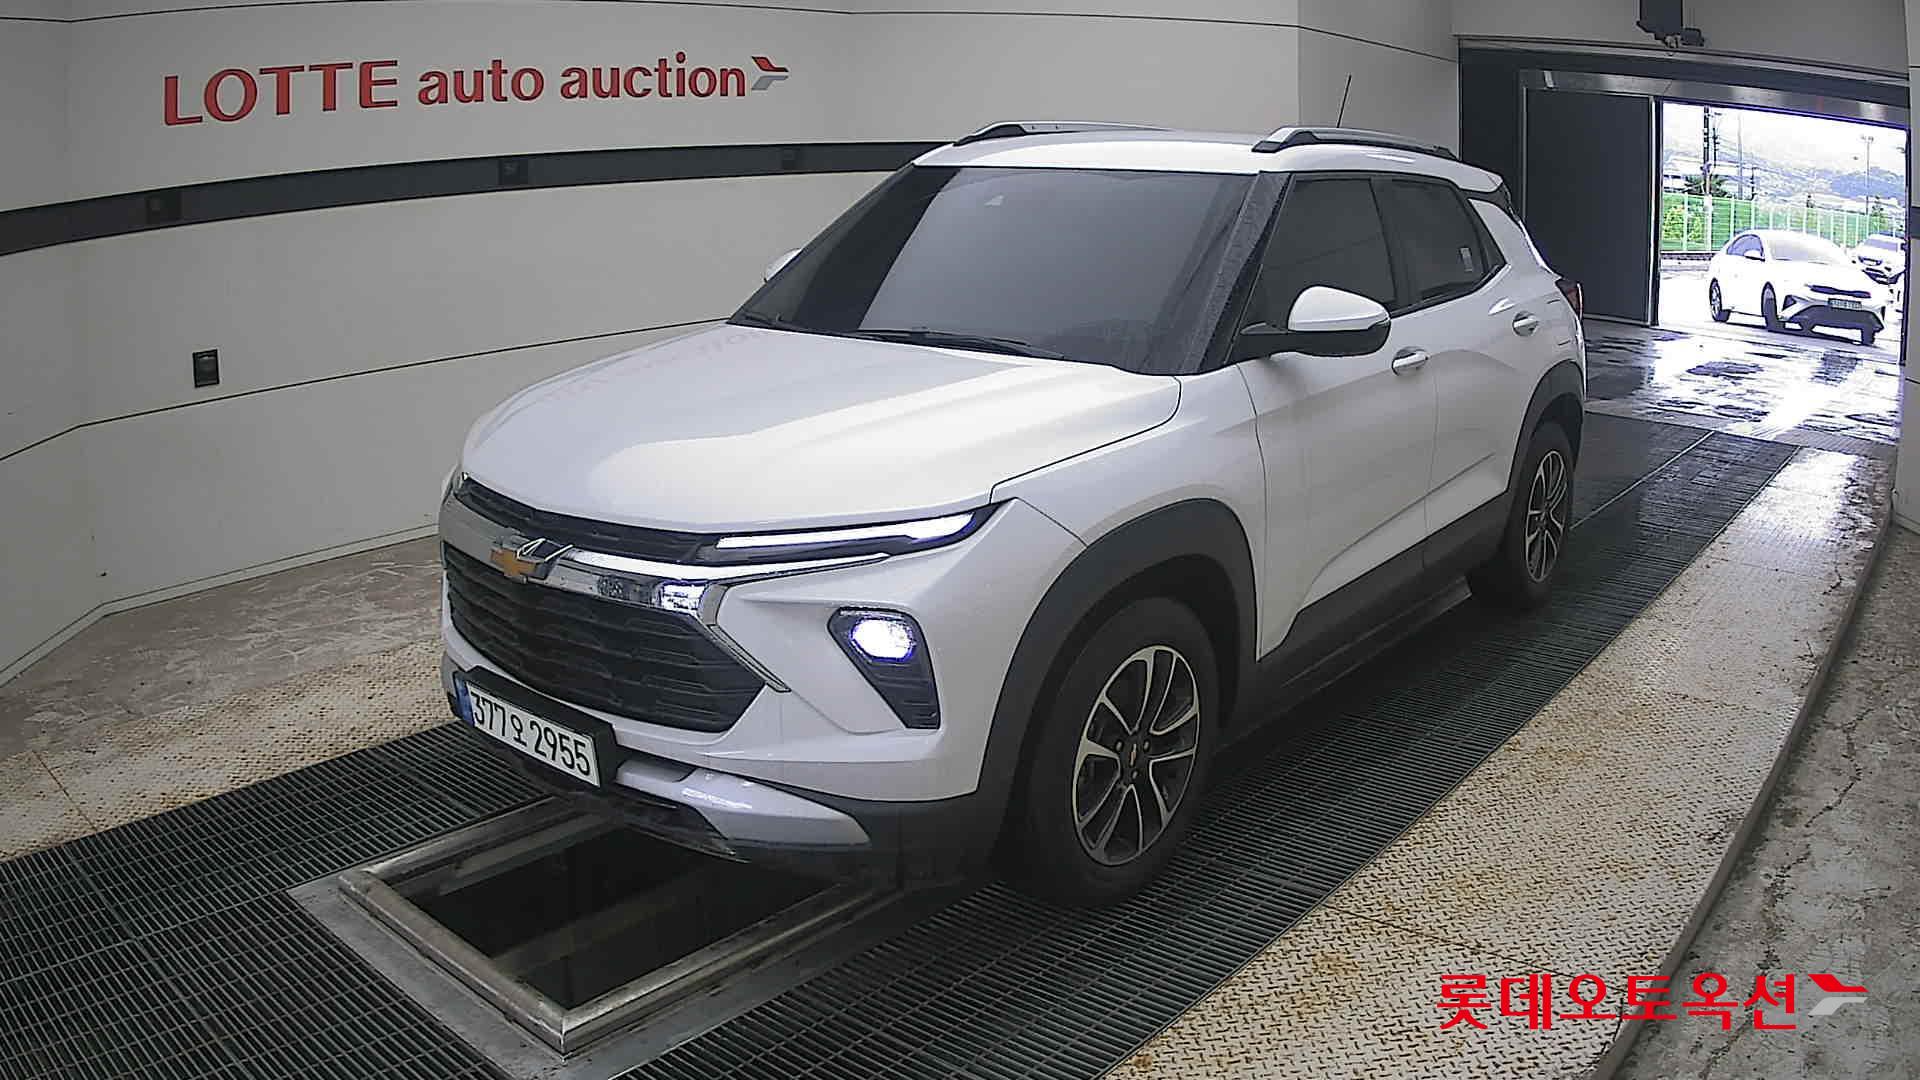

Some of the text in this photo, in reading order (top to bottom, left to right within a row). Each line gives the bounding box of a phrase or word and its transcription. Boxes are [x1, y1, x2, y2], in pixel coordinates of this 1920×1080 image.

[163, 51, 747, 127] LOTTE auto auction
